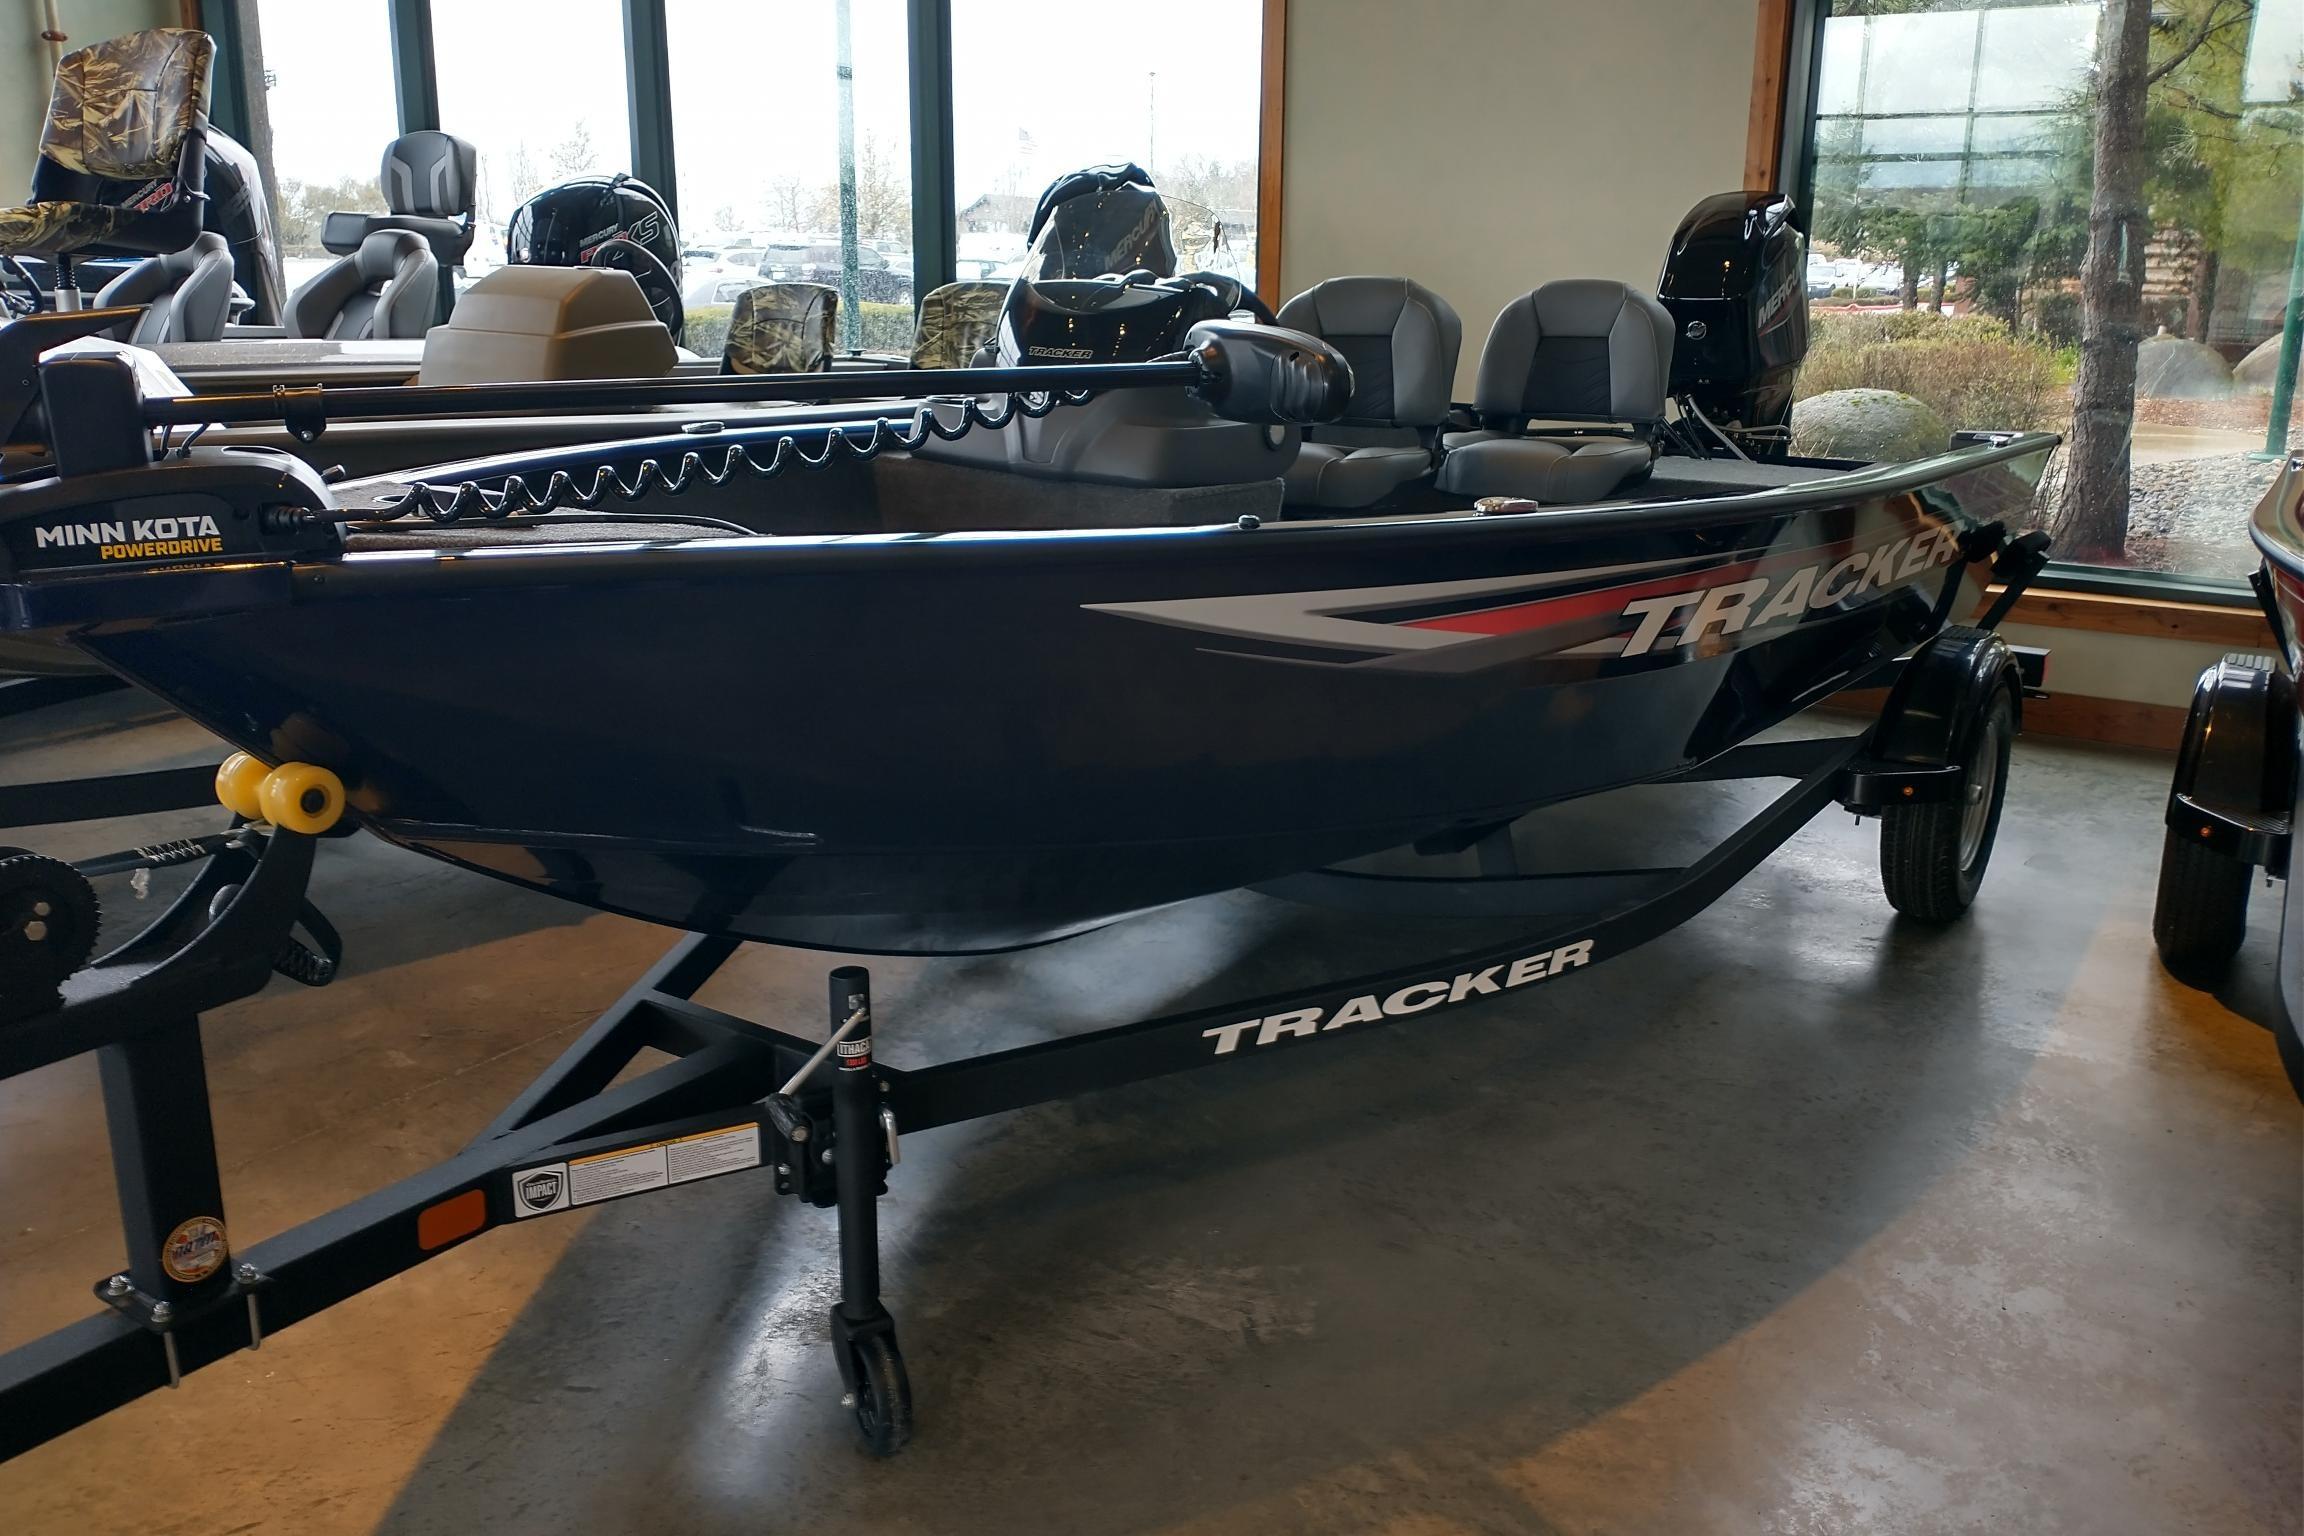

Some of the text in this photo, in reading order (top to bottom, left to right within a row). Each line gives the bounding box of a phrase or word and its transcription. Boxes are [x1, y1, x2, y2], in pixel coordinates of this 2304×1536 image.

[579, 222, 619, 248] MERCURY
[1028, 345, 1093, 359] TRACKER
[35, 515, 220, 548] MINN KOTA
[101, 537, 223, 560] POWERDRIVE
[1620, 520, 1963, 658] TRACKER
[1201, 939, 1595, 1055] TRACKER
[526, 1180, 558, 1200] IMPACT
